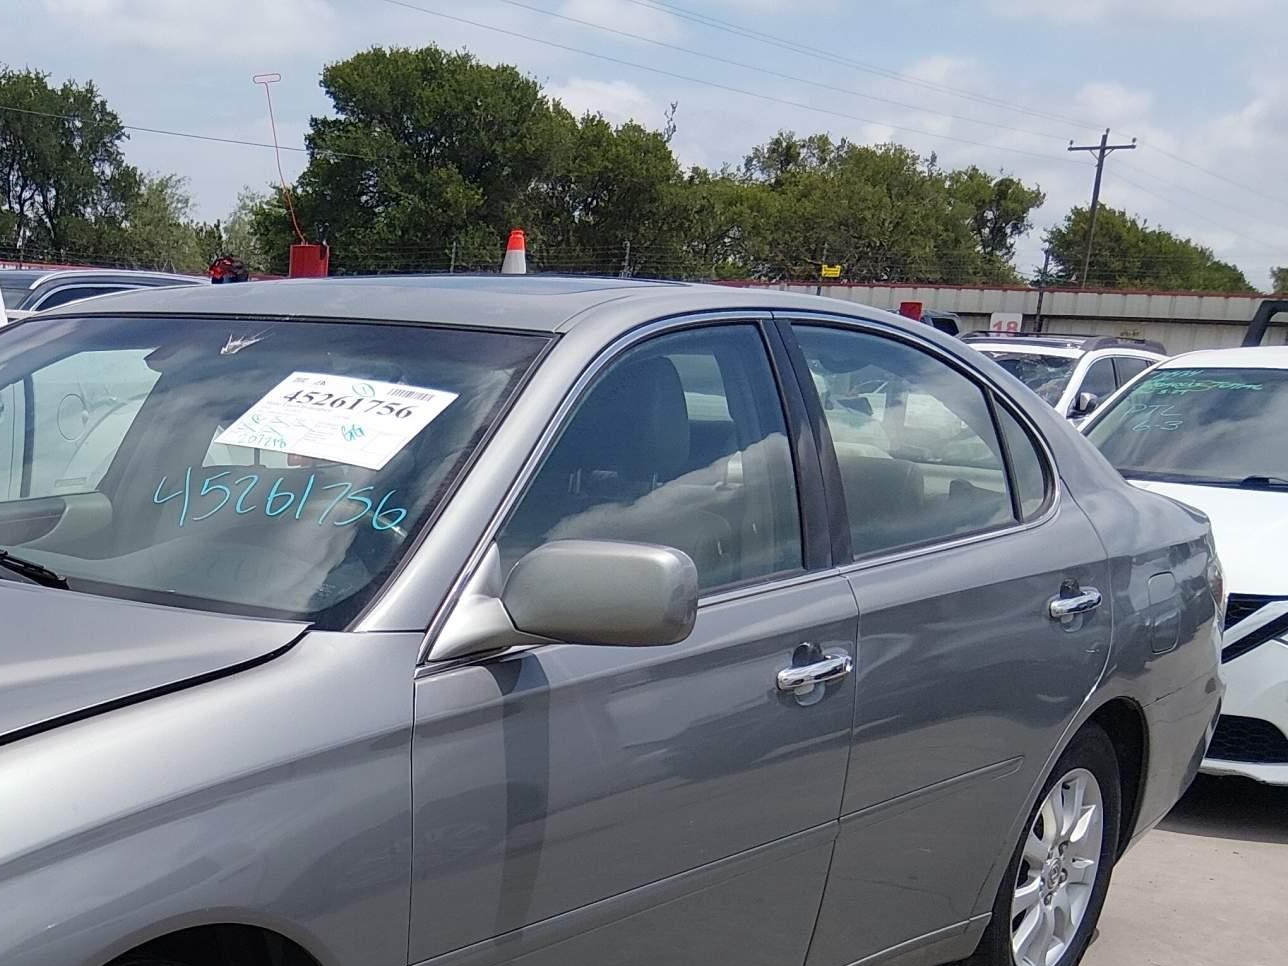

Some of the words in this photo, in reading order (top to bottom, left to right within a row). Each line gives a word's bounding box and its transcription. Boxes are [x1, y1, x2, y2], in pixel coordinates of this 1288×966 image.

[993, 320, 1018, 337] 18
[283, 390, 416, 420] 45261756
[153, 466, 407, 531] 45261756
